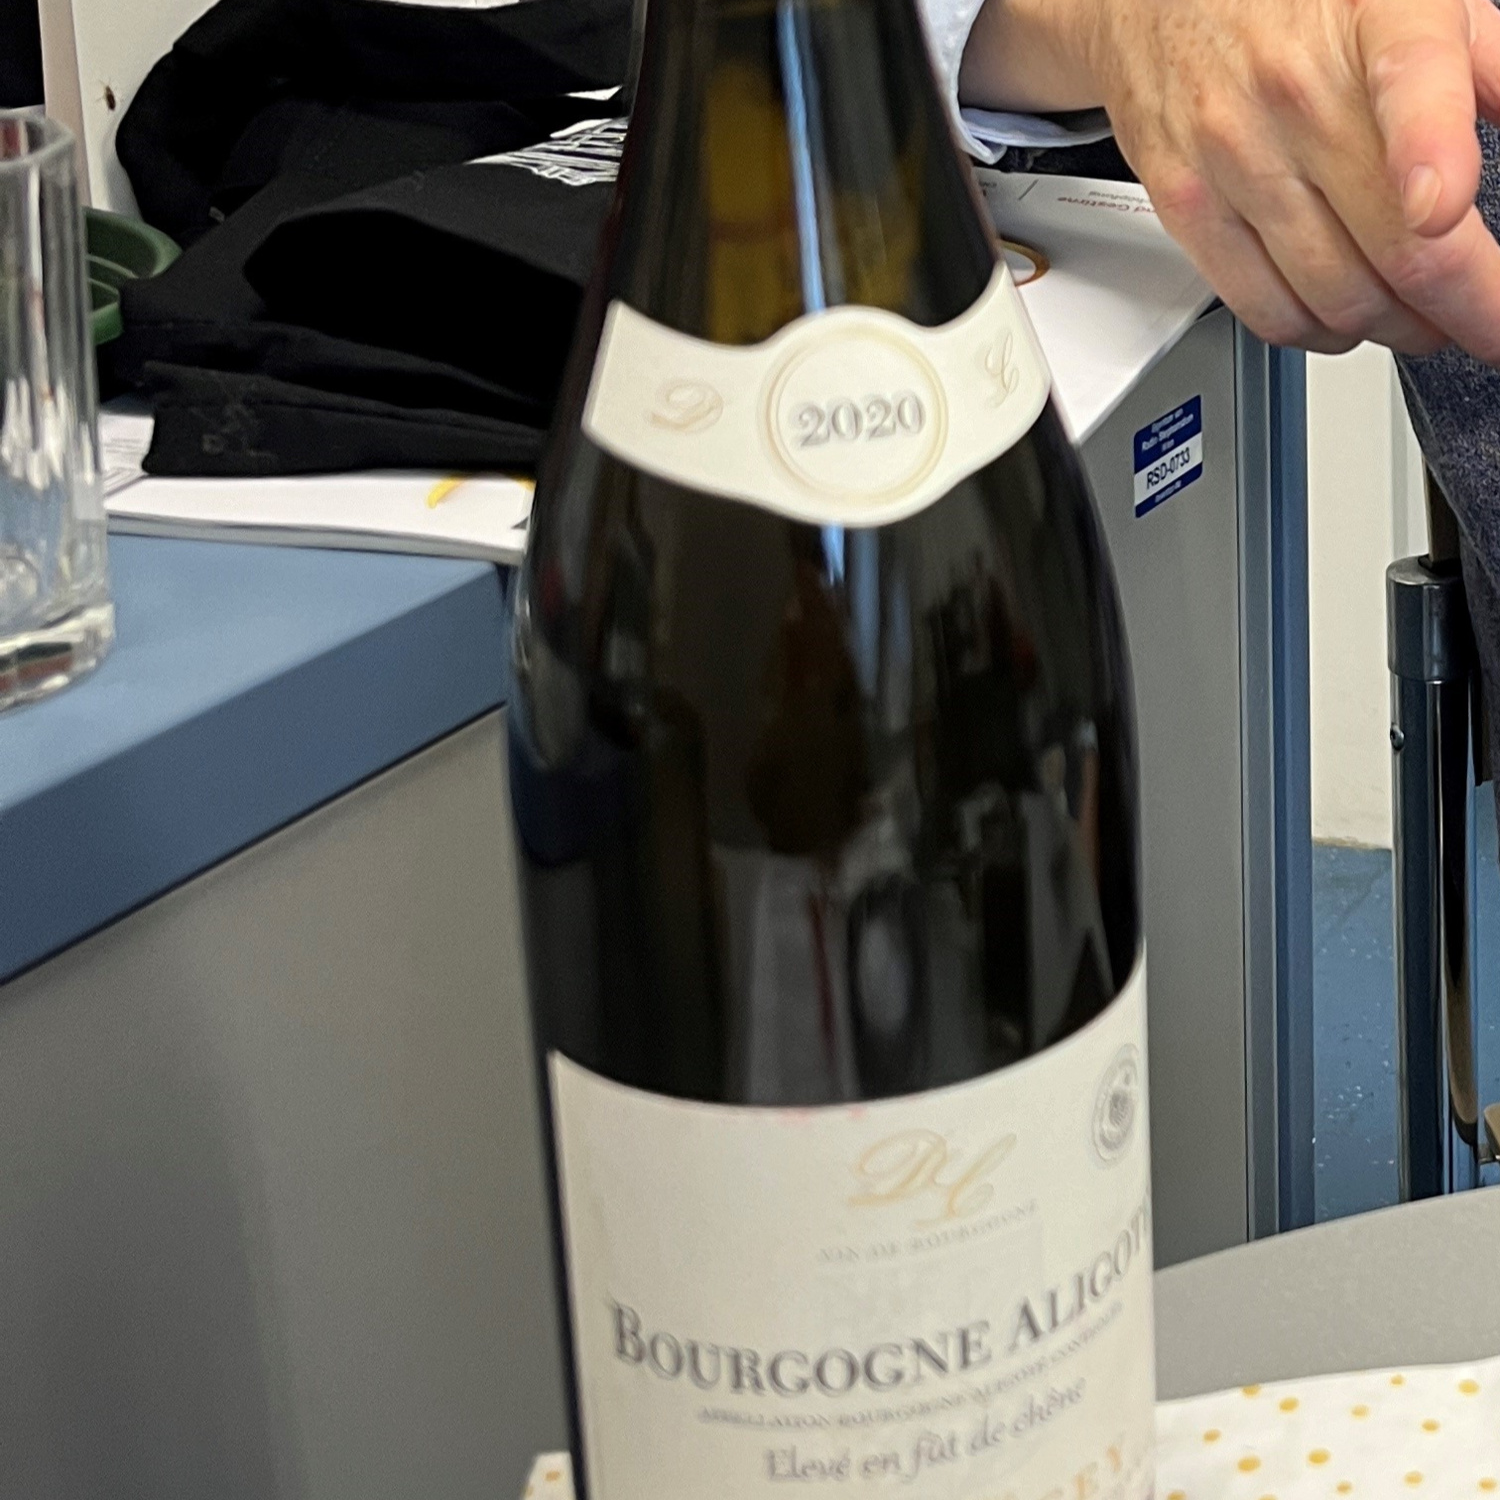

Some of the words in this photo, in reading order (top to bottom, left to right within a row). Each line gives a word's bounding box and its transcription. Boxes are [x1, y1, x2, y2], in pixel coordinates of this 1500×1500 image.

[790, 388, 927, 447] 2020
[606, 1297, 992, 1397] BOURGOGNE
[859, 1451, 901, 1477] en
[965, 1411, 1008, 1457] de
